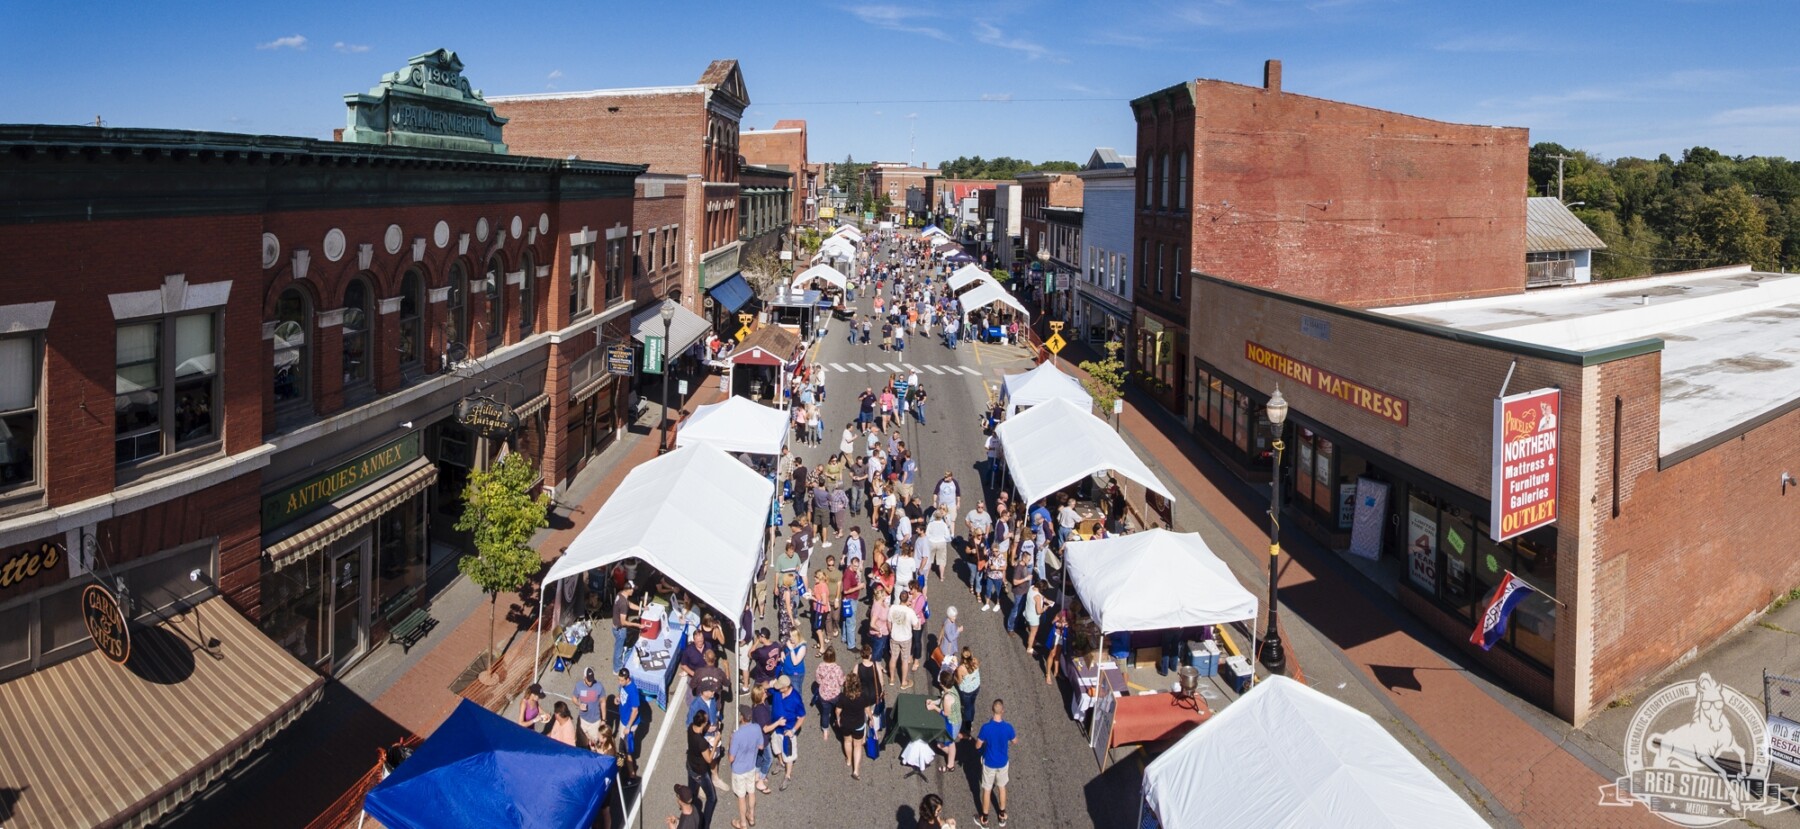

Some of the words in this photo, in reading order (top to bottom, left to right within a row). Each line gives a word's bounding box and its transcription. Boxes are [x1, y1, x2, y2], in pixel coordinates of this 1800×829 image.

[428, 68, 458, 86] 1908
[1248, 344, 1312, 385] NORTHERN
[1318, 371, 1403, 422] MATTRESS
[464, 414, 508, 431] Antiques
[1505, 430, 1556, 463] NORTHERN
[286, 466, 357, 514] ANTIQUES
[360, 444, 402, 479] ANNEX
[1505, 458, 1545, 480] Mattress
[1548, 453, 1555, 466] &
[1510, 473, 1550, 494] Furniture
[1510, 487, 1549, 510] Galleries
[1502, 499, 1555, 533] OUTLET
[1415, 534, 1431, 556] 4
[1415, 559, 1436, 580] NO
[89, 592, 122, 634] CARDS
[101, 615, 112, 634] &
[89, 615, 122, 657] GIFTS
